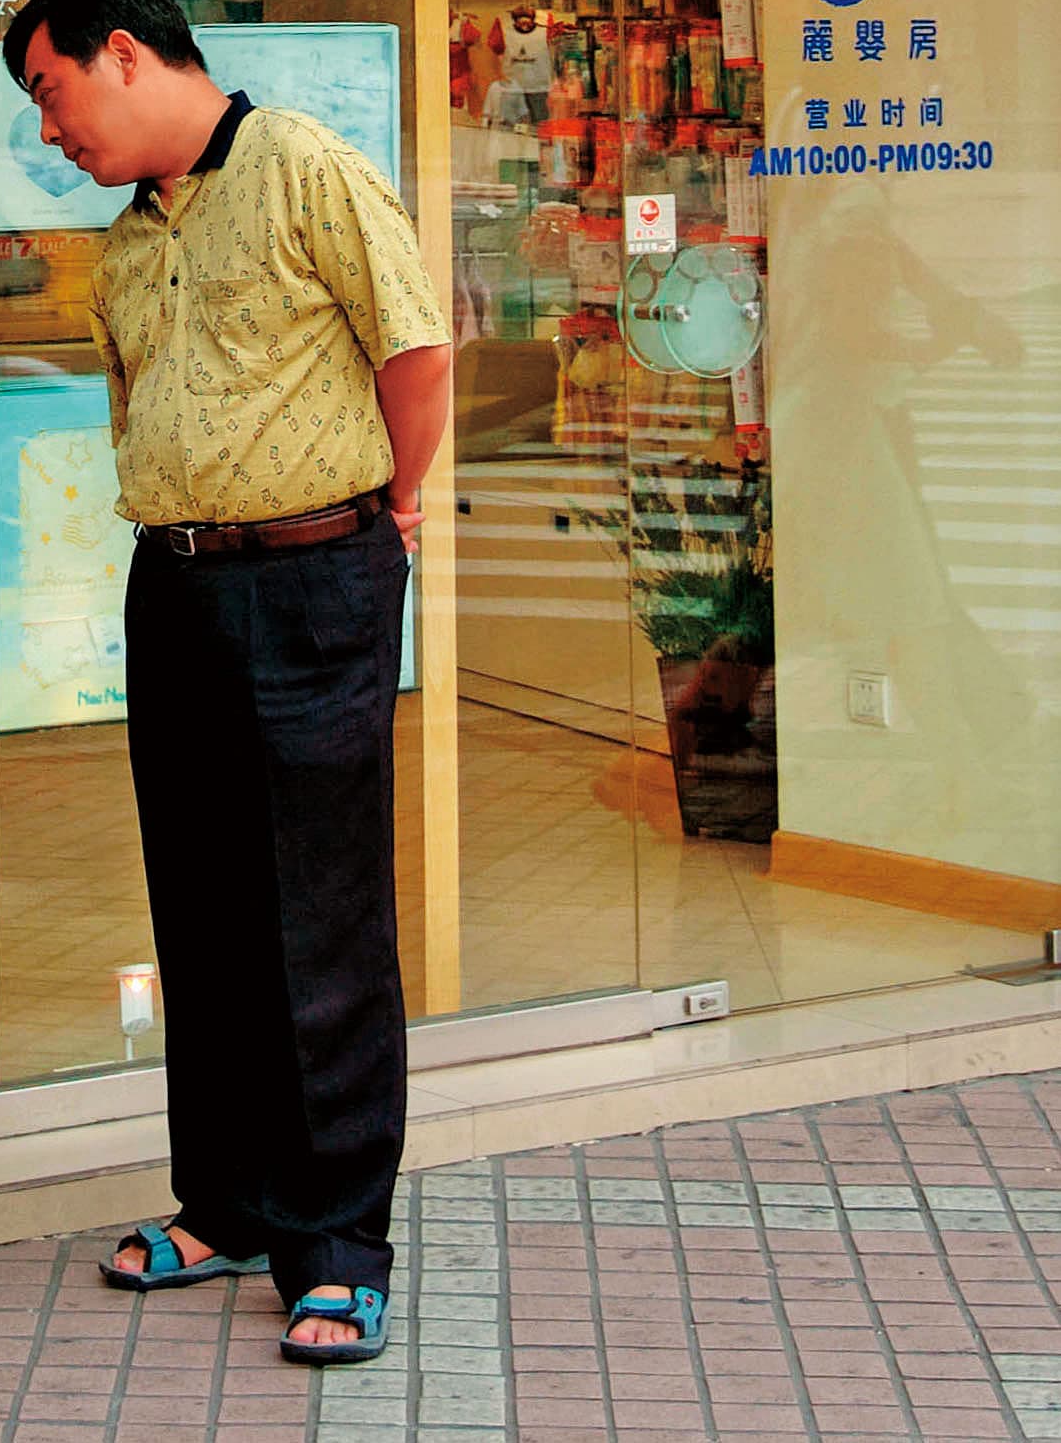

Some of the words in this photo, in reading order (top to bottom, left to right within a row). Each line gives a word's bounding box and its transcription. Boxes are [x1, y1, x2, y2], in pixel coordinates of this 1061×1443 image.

[802, 19, 937, 61] 麗嬰房
[804, 97, 943, 129] 营业时间
